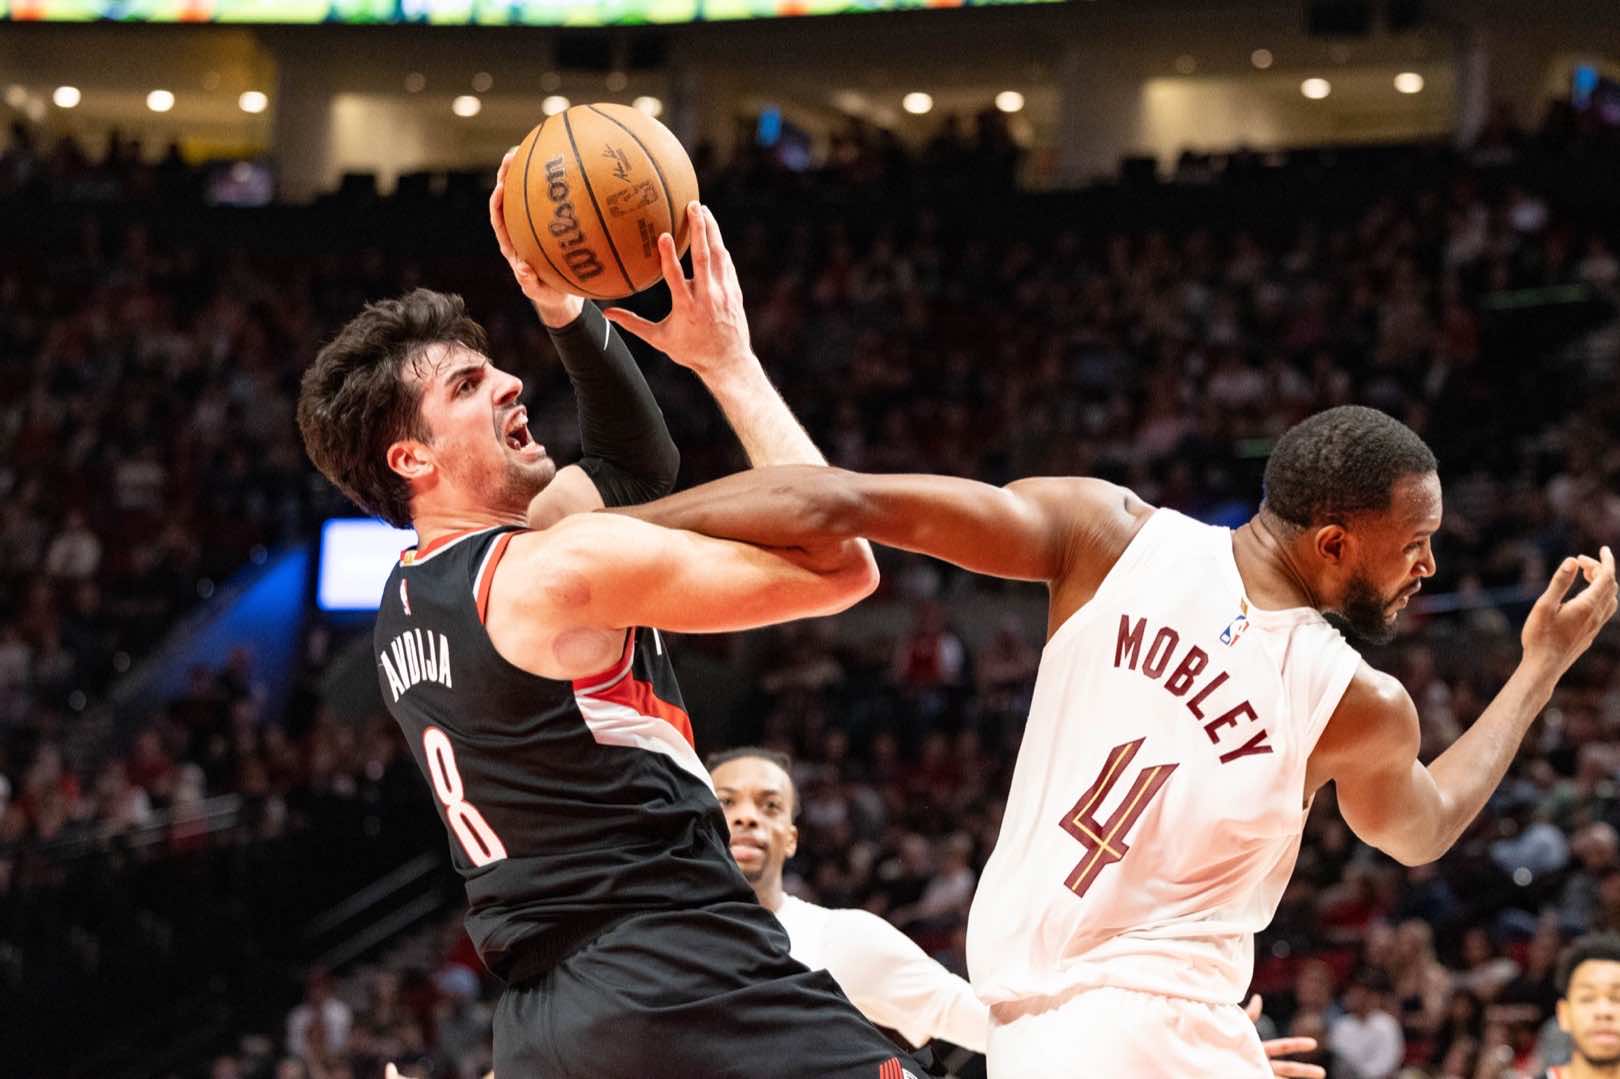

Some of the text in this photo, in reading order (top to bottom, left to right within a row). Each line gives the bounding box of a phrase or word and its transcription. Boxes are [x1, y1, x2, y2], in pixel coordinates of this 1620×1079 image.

[545, 155, 605, 282] Wilson
[380, 628, 452, 703] AVDIJA
[1113, 613, 1274, 764] MOBLEY
[422, 725, 509, 868] 8
[1058, 736, 1180, 899] 4
